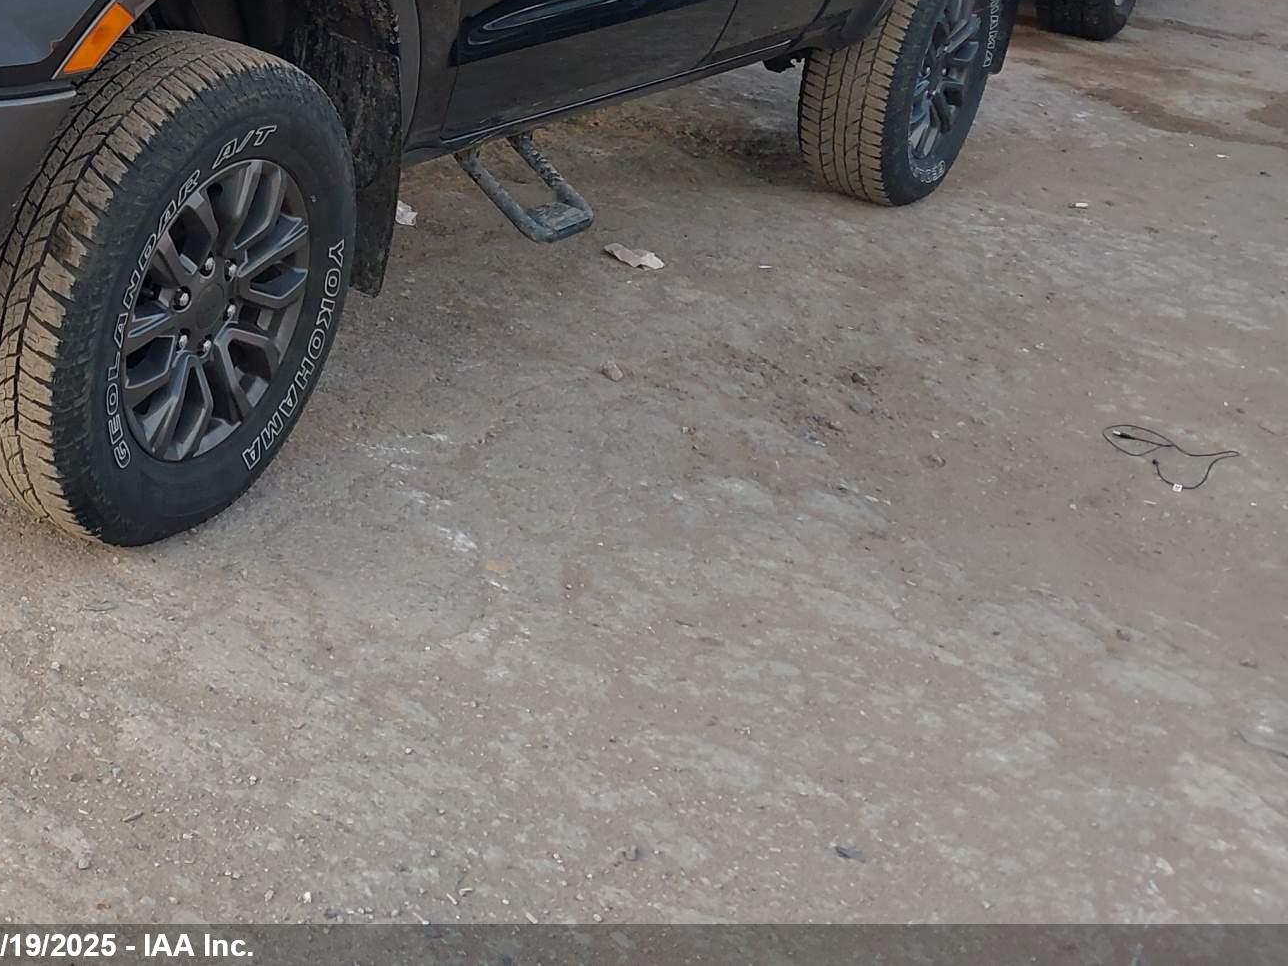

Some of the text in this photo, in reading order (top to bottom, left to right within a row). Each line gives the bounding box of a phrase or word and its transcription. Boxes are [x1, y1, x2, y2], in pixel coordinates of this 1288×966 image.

[211, 124, 278, 170] A/T
[105, 169, 201, 469] GEOLANDAR
[241, 238, 346, 471] YOKOHAMA
